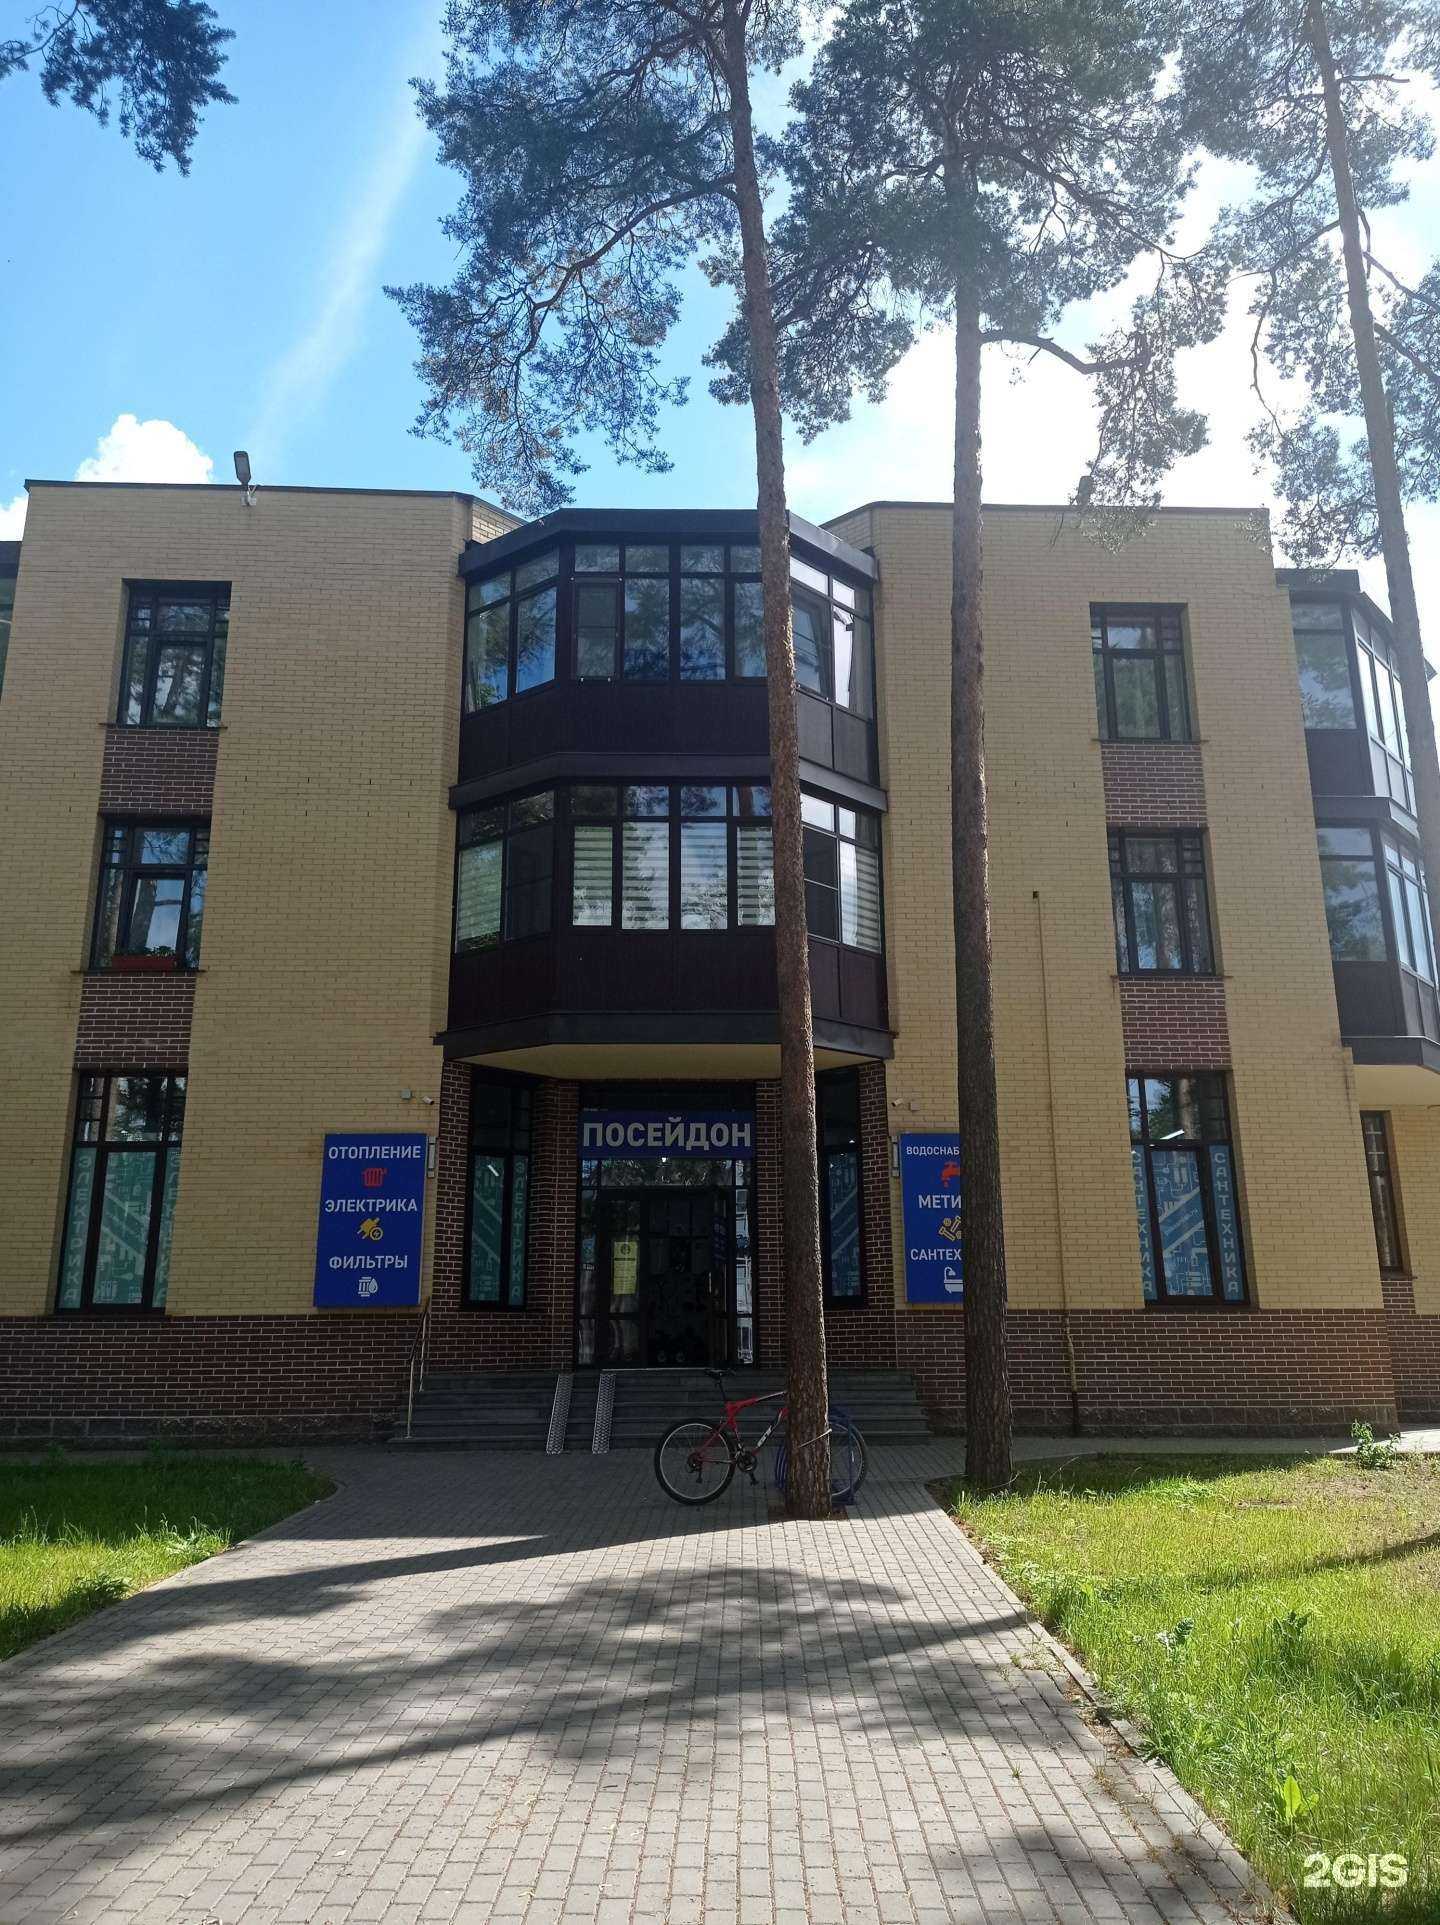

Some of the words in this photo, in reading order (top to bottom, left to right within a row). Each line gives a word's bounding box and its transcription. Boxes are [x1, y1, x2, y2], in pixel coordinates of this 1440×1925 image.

[583, 1117, 751, 1151] ПОСЕЙДОН
[328, 1145, 421, 1159] ОТОПЛЕНИЕ
[906, 1146, 960, 1157] ВОДОСНАБ
[325, 1199, 418, 1212] ЭЛЕКТРИКА
[918, 1194, 962, 1208] МЕТИ
[64, 1155, 92, 1300] ЭЛЕКТРИКА
[512, 1161, 525, 1297] ЭЛЕКТРИКА
[1214, 1152, 1239, 1293] САНТЕХНИКА
[910, 1248, 962, 1261] САНТЕХ
[329, 1255, 408, 1269] ФИЛЬТРЫ
